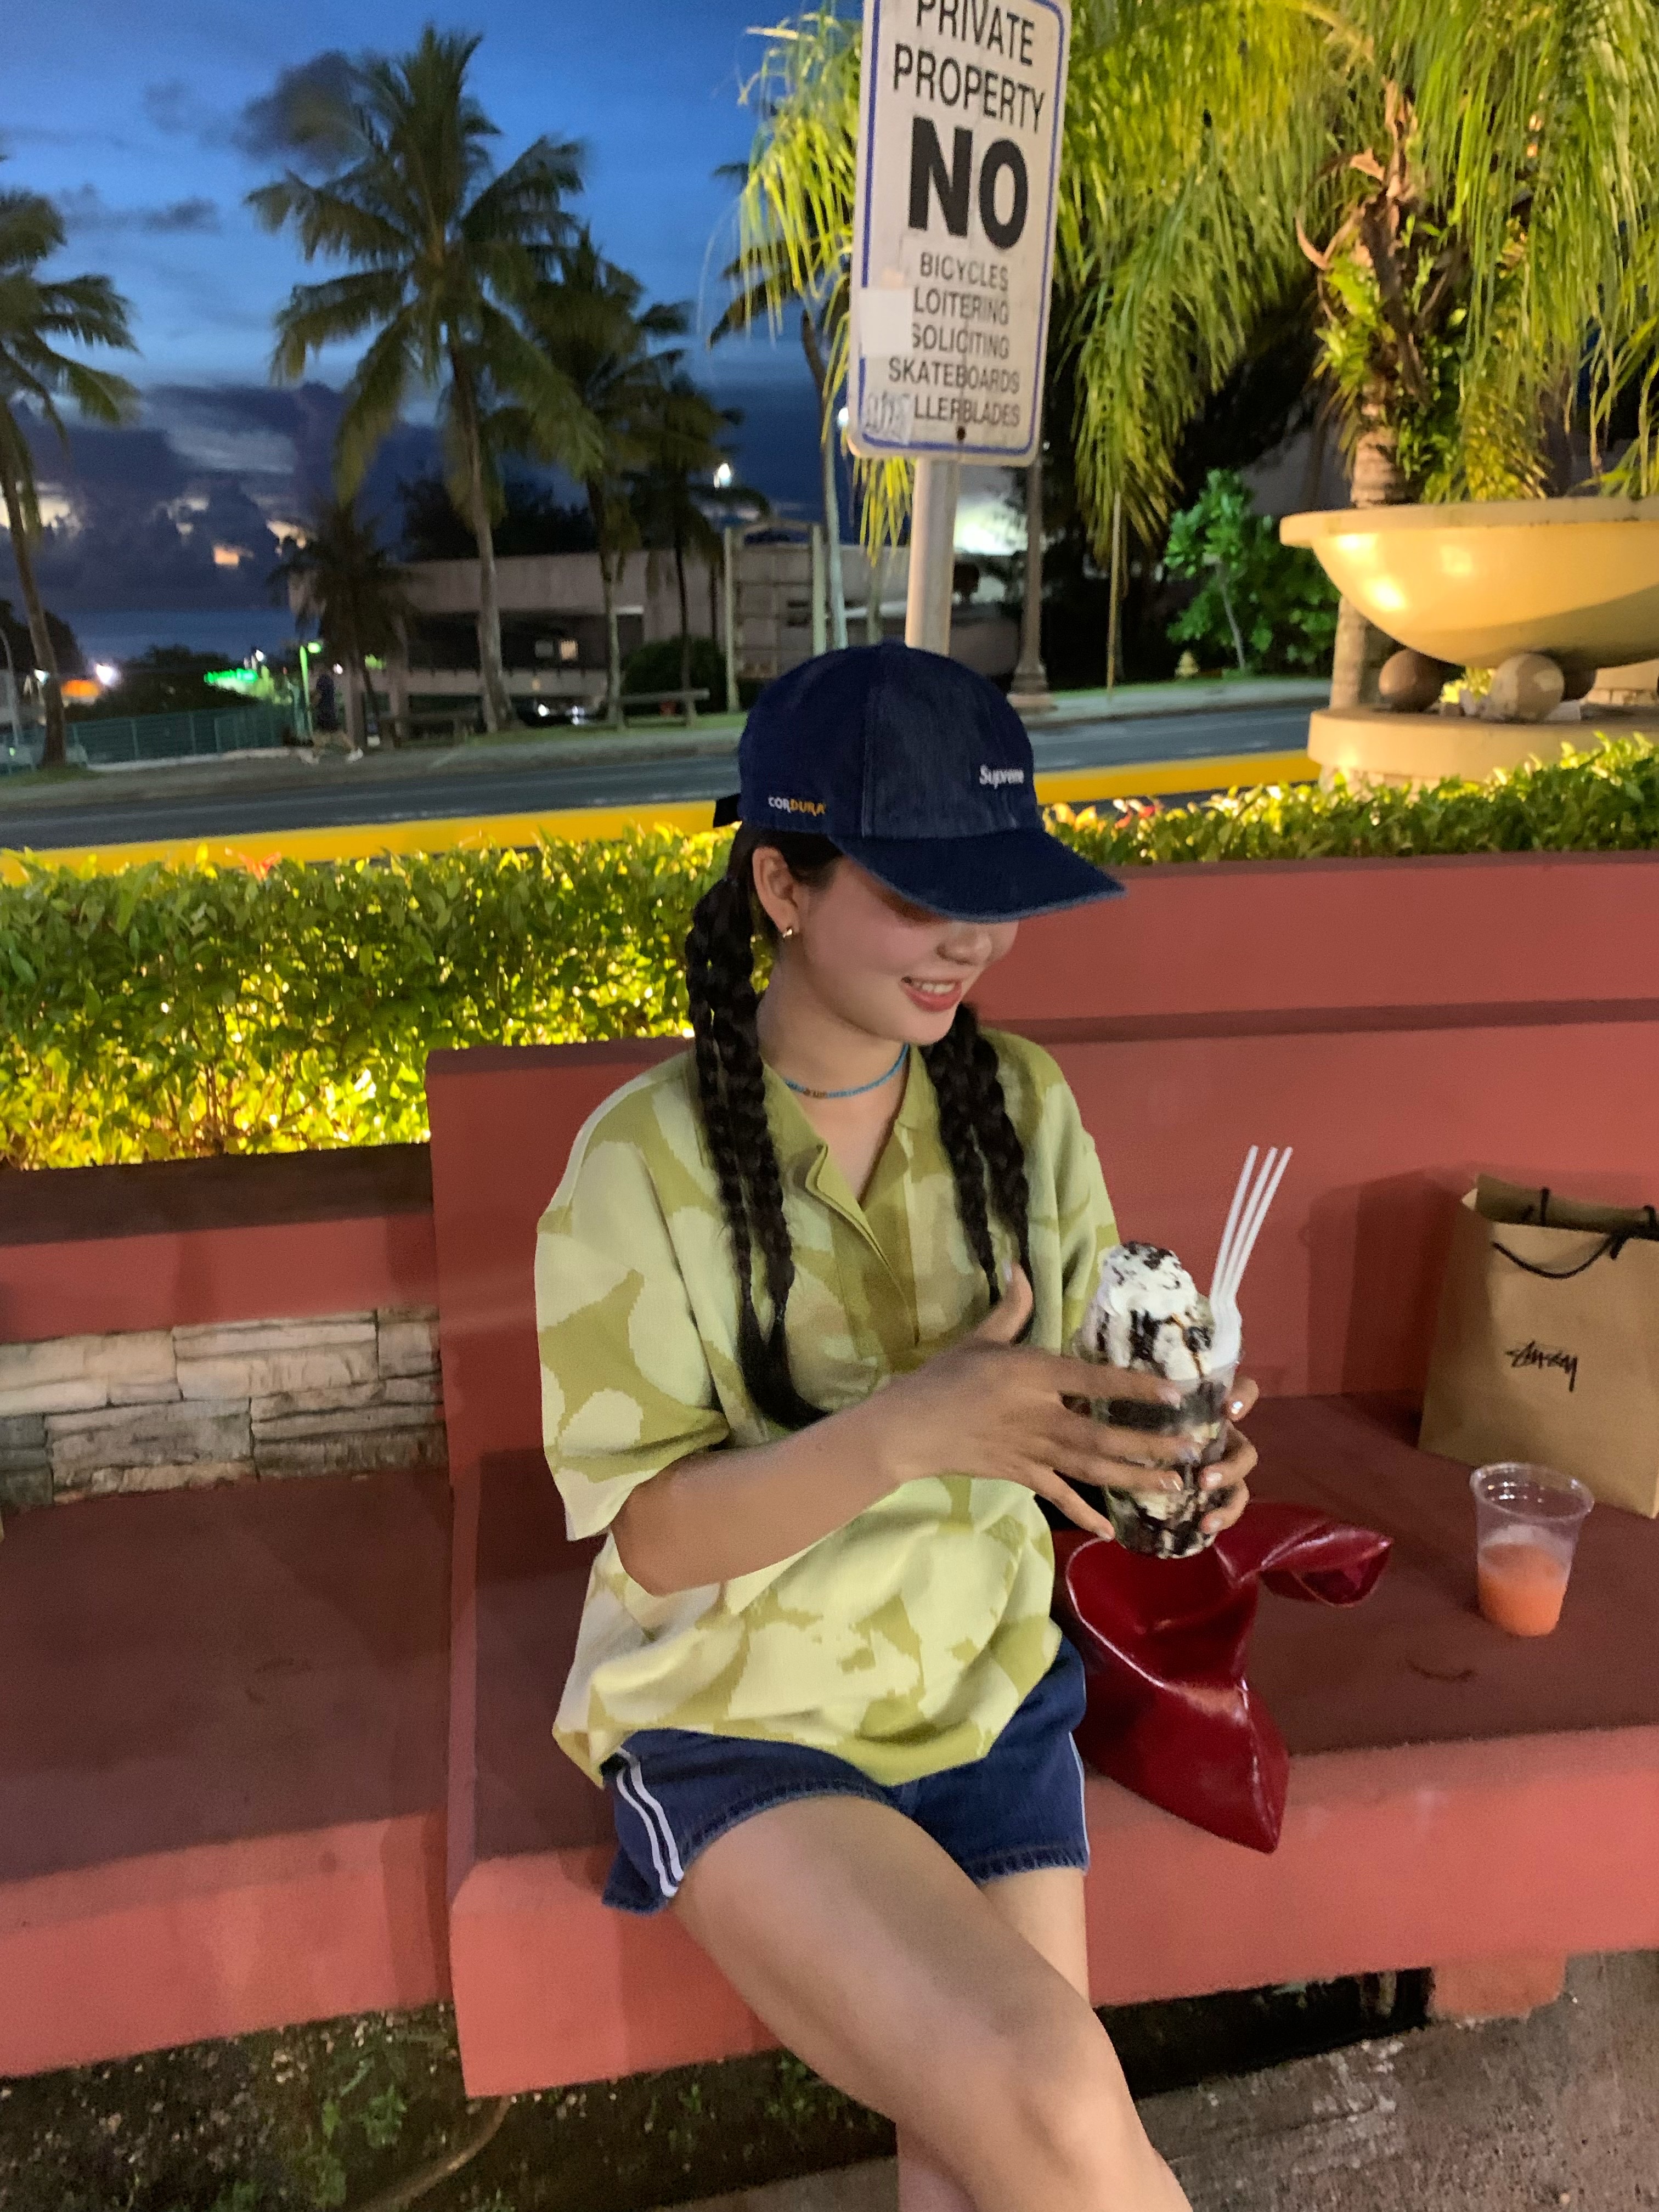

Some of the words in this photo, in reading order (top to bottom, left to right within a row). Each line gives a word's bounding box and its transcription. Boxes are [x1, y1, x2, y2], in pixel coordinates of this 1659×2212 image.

[916, 0, 1035, 65] PRIVATE
[894, 43, 1045, 133] PROPERTY
[909, 115, 1029, 250] NO
[920, 252, 1009, 292] BICYCLES
[913, 286, 1009, 325] LOITERING
[912, 323, 1010, 360] SOLICITING
[888, 356, 1020, 394] SKATEBOARDS
[914, 393, 1020, 427] LLERBLADES
[768, 796, 826, 816] CORDURA
